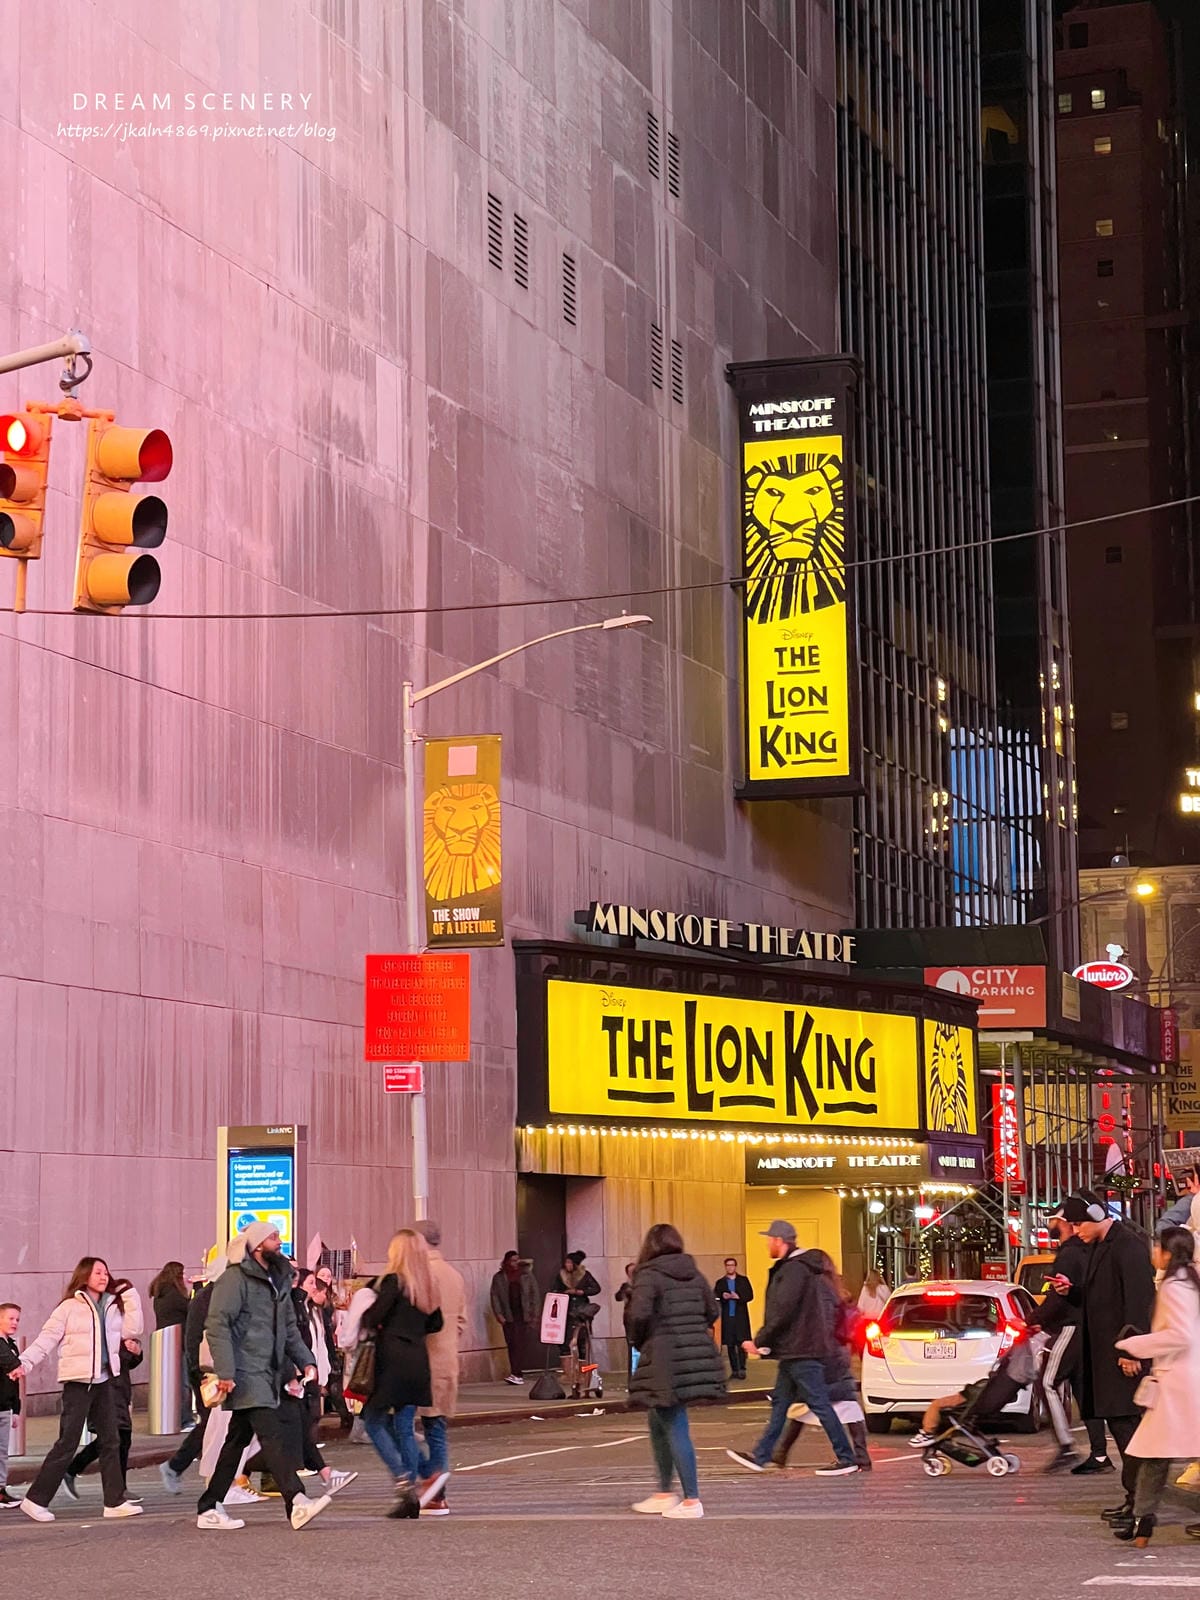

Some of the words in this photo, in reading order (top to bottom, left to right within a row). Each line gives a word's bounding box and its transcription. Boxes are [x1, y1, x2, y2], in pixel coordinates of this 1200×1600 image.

[749, 398, 836, 416] MINSKOFF
[752, 415, 834, 432] THEATRE
[774, 645, 820, 668] THE
[766, 680, 828, 719] LION
[760, 724, 837, 768] KING
[432, 908, 451, 922] THE
[452, 907, 481, 921] SHOW
[432, 922, 445, 936] OF
[446, 921, 454, 935] A
[455, 919, 497, 935] LIFETIME
[592, 902, 735, 949] MINSKOFF
[744, 922, 858, 964] THEATRE
[971, 968, 1019, 985] CITY
[971, 986, 1036, 997] PARKING
[601, 1015, 675, 1081] THE
[684, 1000, 774, 1113] LION
[784, 1010, 877, 1121] KING
[757, 1156, 838, 1169] MINSKOFF
[846, 1155, 921, 1167] THEATRE
